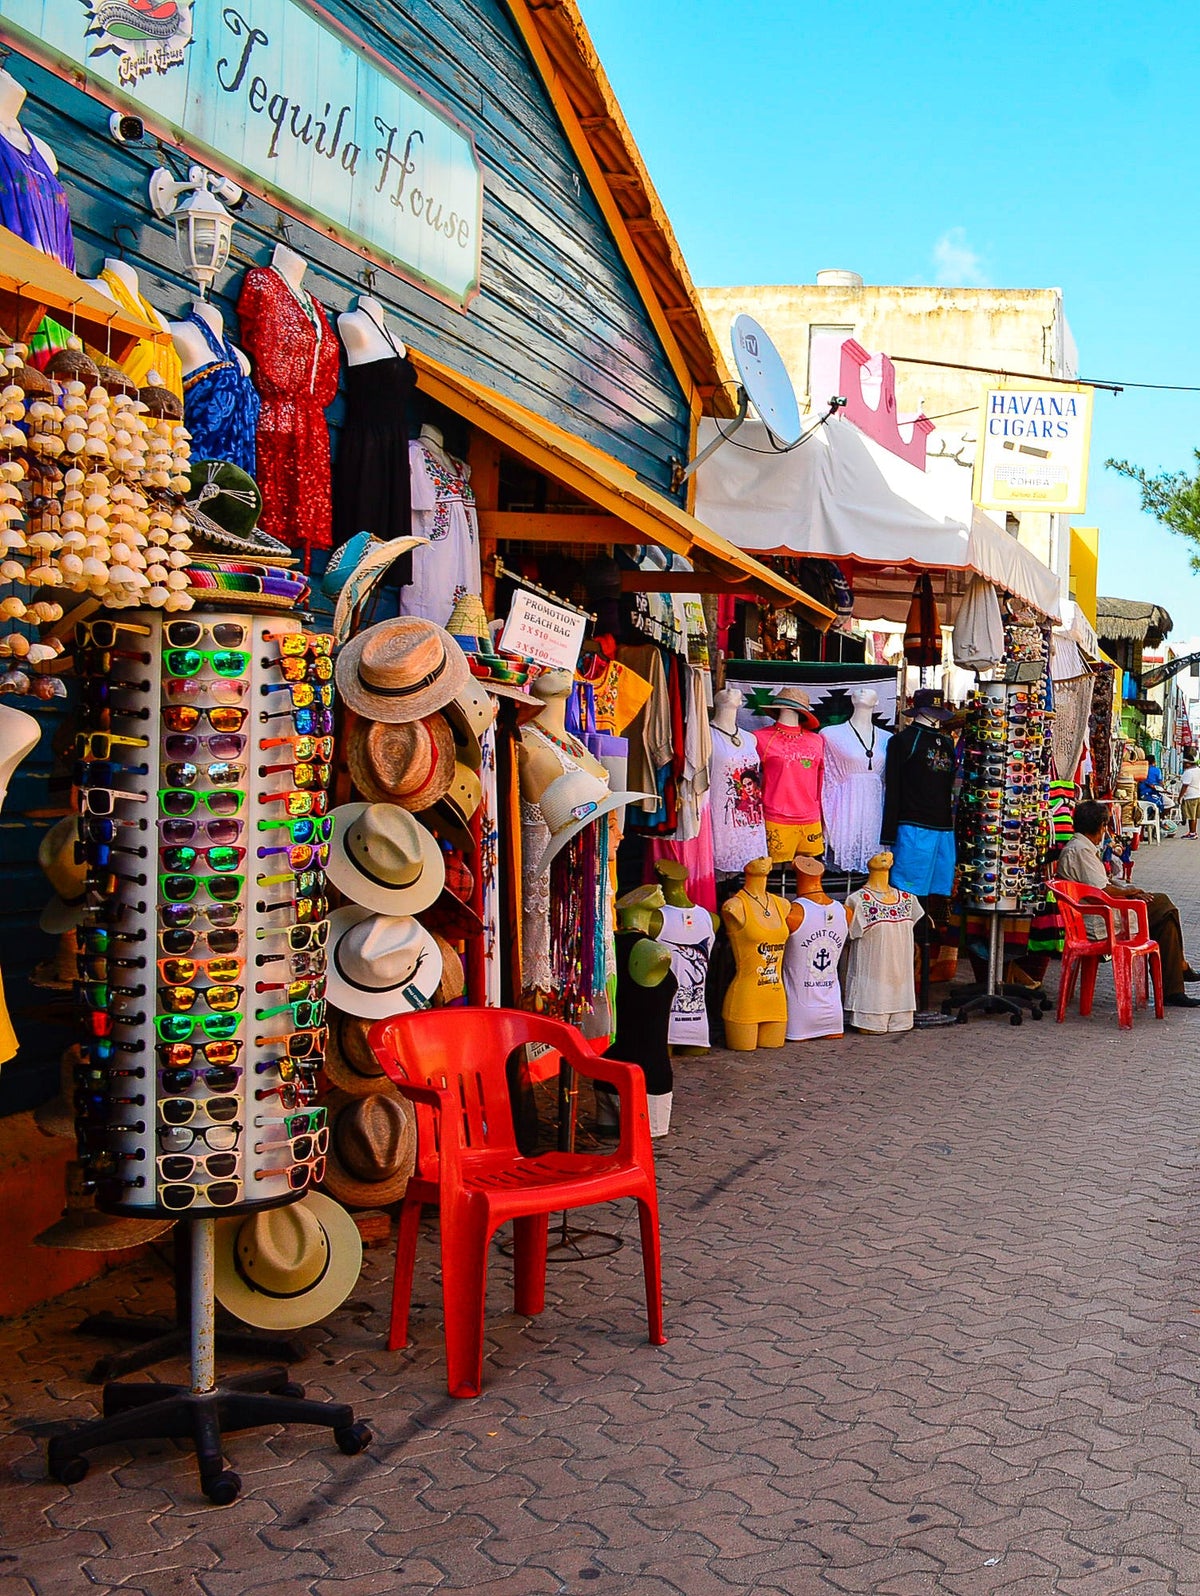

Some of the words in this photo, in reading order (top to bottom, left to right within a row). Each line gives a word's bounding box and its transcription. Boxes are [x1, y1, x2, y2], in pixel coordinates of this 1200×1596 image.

[122, 50, 153, 76] Tequila
[154, 44, 183, 67] House
[217, 8, 362, 177] Tequila
[374, 116, 470, 249] House
[991, 395, 1077, 416] HAVANA
[989, 418, 1068, 438] CIGARS
[520, 623, 526, 632] 3
[534, 628, 549, 640] $10
[523, 611, 553, 631] BEACH
[553, 624, 571, 637] BAG
[515, 641, 522, 649] 3
[529, 645, 549, 660] $100
[1164, 657, 1190, 675] DOS
[801, 929, 827, 950] YACHT
[828, 930, 843, 949] CLUB
